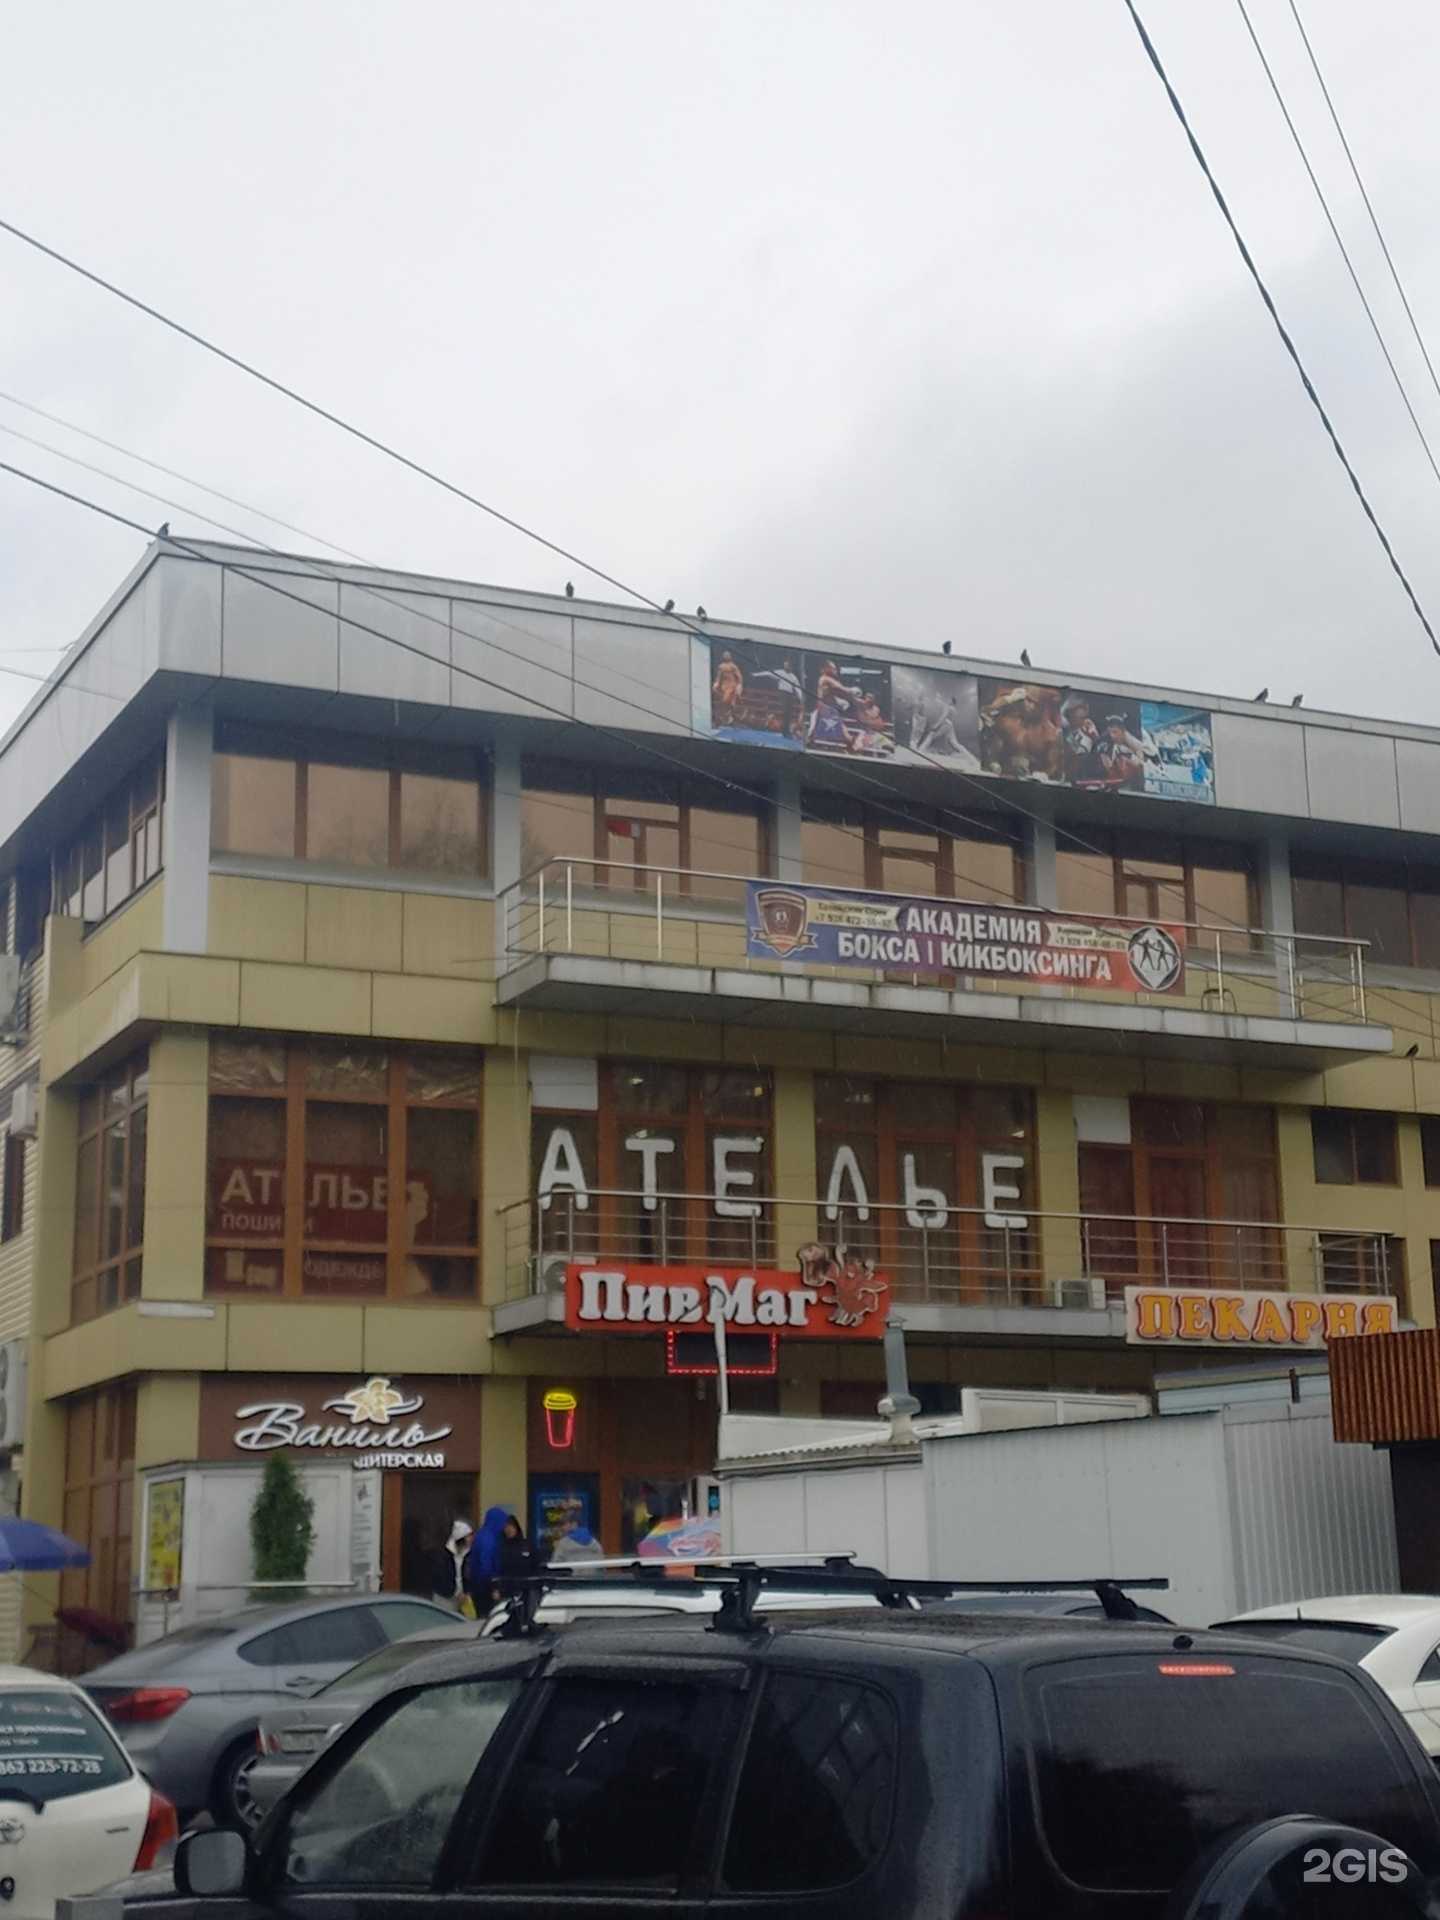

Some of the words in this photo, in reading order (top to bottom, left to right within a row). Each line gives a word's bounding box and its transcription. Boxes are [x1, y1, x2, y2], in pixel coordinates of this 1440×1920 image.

[906, 906, 1042, 945] АКАДЕМИЯ
[837, 931, 921, 964] БОКСА
[940, 942, 1113, 981] КИКБОКСИНГА
[221, 1167, 388, 1212] АТЛЬЕ
[538, 1127, 1029, 1230] АТЕЛЬЕ
[578, 1271, 818, 1327] ПивМаг
[1136, 1295, 1394, 1342] ПЕКАРНЯ
[234, 1403, 453, 1450] Ваниль
